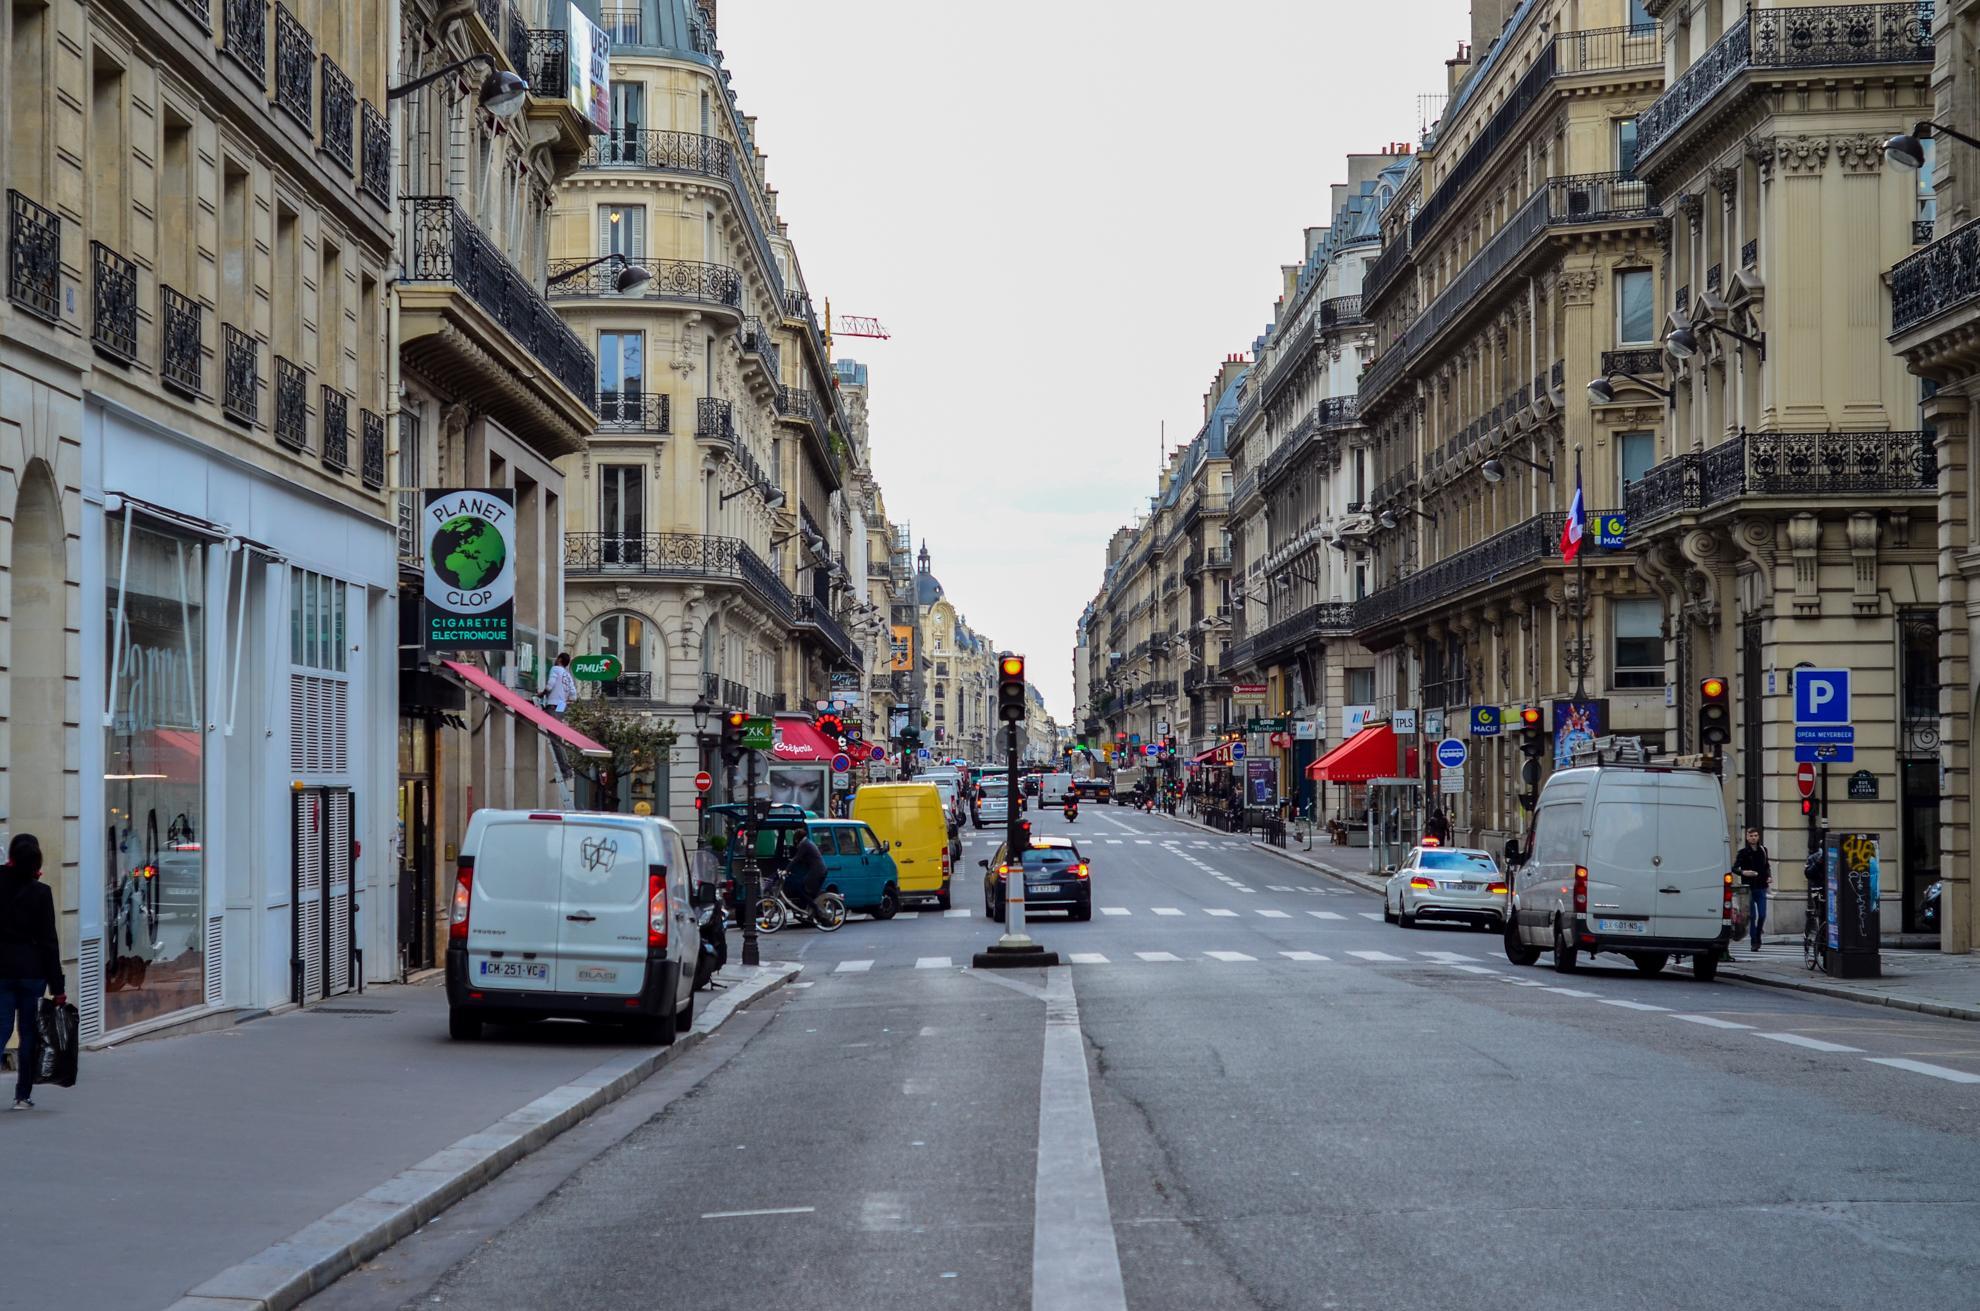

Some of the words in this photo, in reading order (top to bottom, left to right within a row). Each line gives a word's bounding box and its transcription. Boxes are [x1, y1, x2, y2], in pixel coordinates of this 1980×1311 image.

[432, 498, 506, 523] PLANET
[1603, 537, 1625, 545] MAC
[446, 590, 493, 606] CLOP
[431, 618, 508, 628] CIGARETTE
[431, 630, 508, 640] ELECTRONIQUE
[575, 663, 598, 673] PMU
[1809, 679, 1835, 714] P
[1396, 718, 1414, 729] TPLS
[1473, 725, 1498, 733] MACIF
